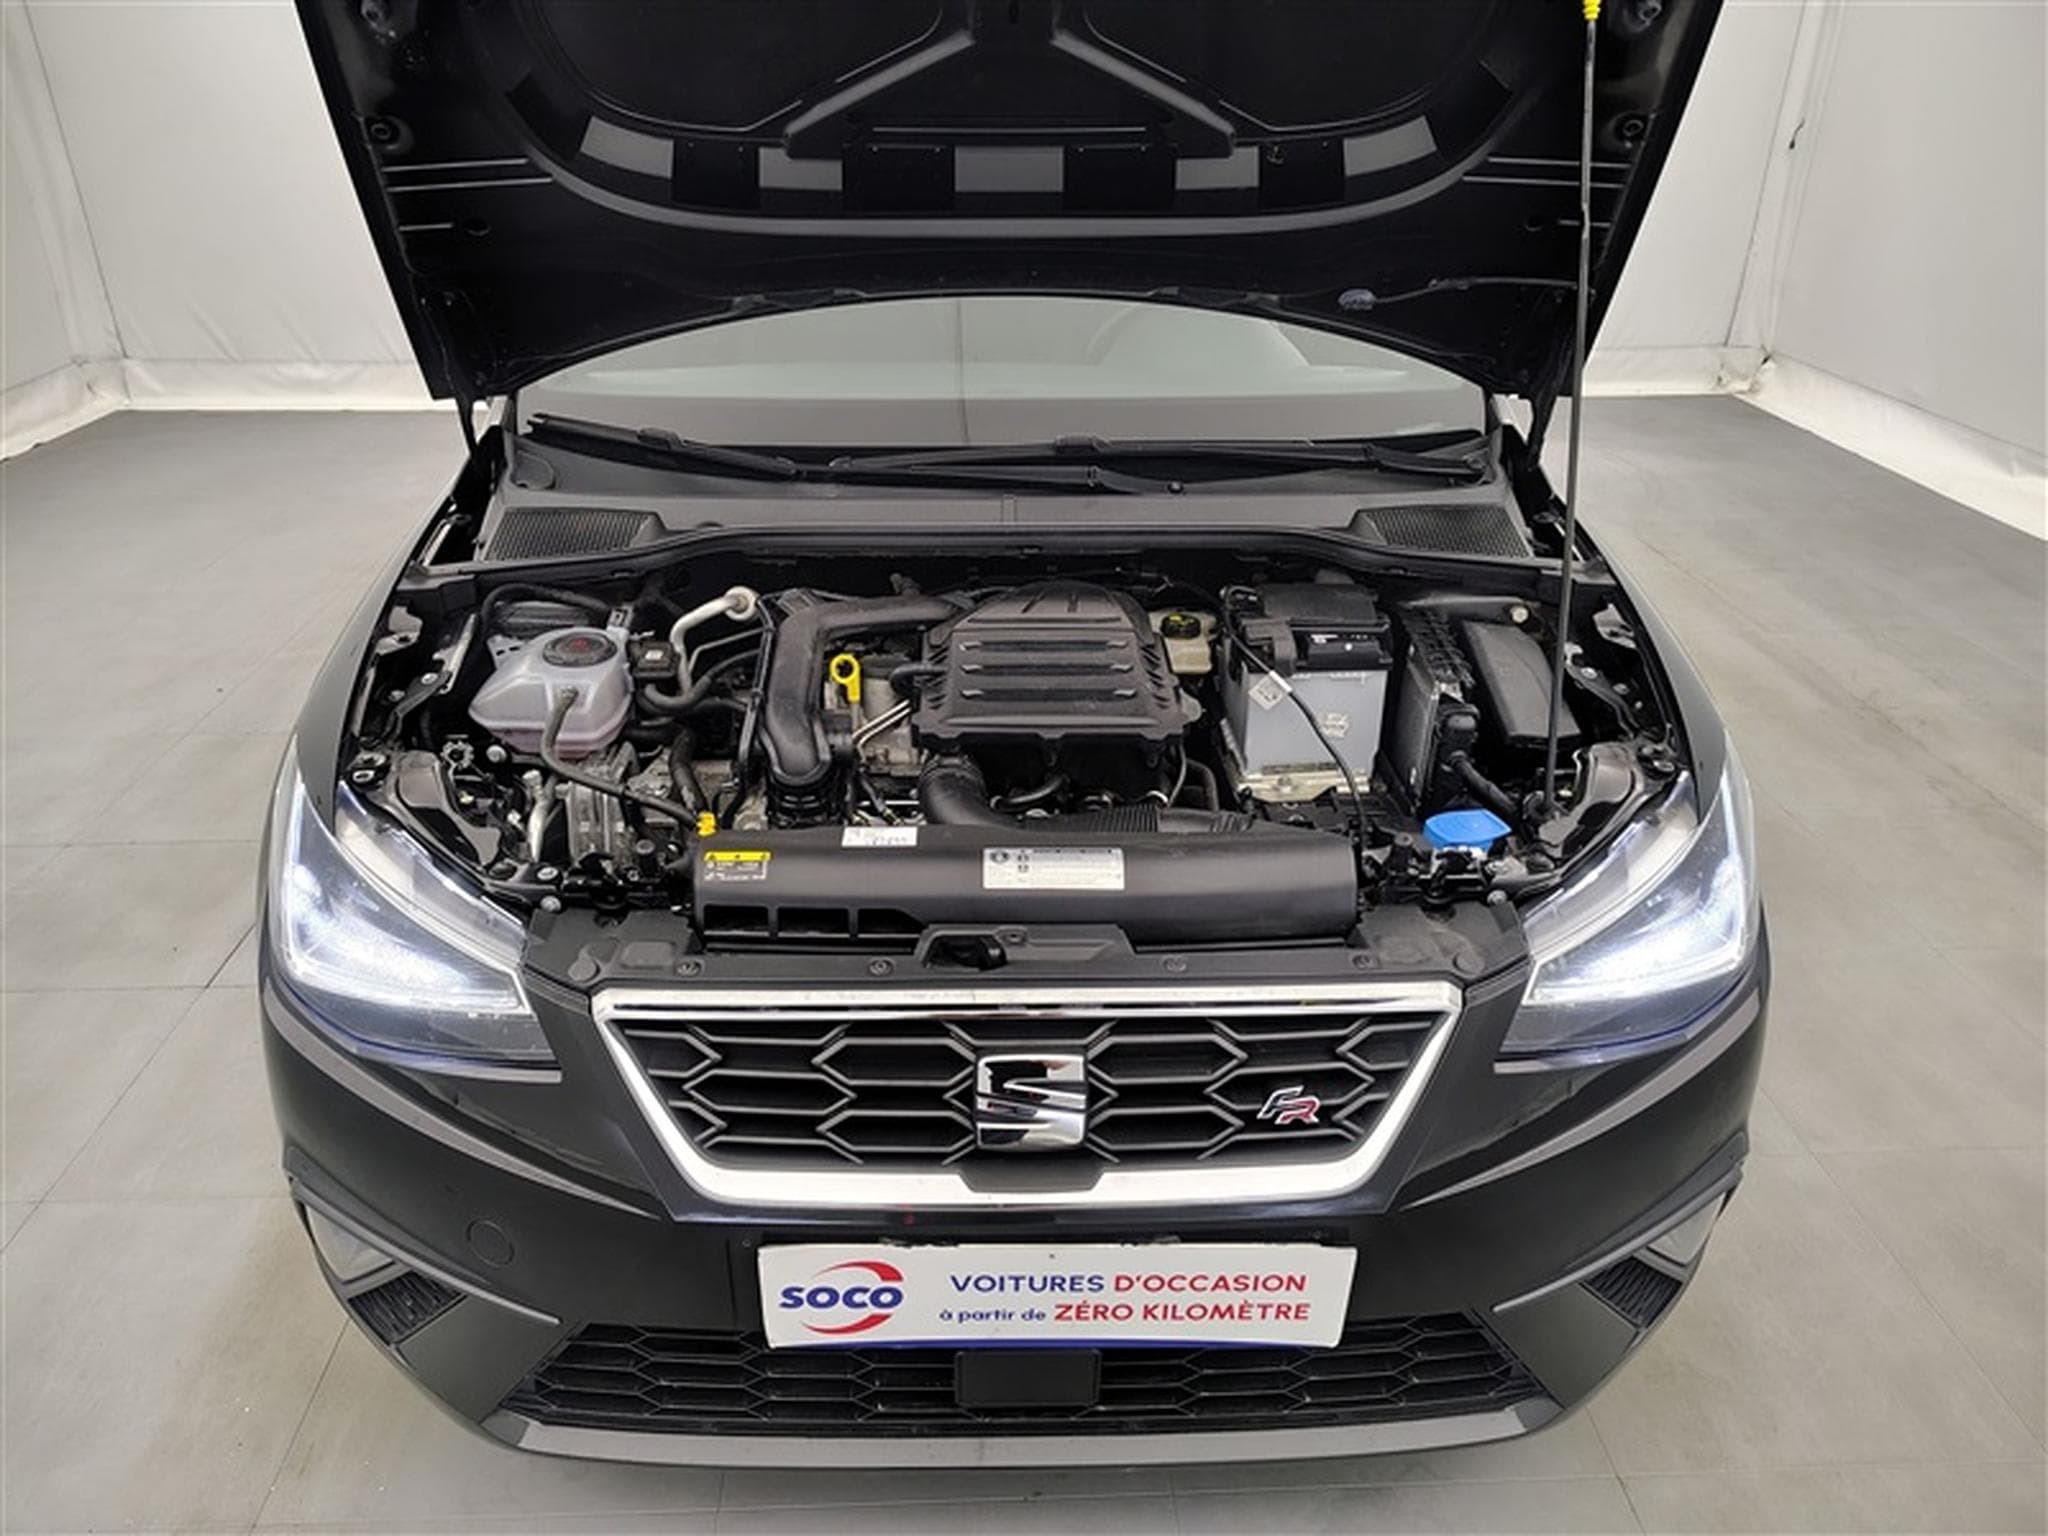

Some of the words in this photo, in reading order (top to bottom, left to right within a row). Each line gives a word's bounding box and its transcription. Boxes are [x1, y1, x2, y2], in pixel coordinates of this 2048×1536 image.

[950, 1274, 1105, 1293] VOITURES
[1113, 1274, 1307, 1293] D'OCCASION
[779, 1285, 904, 1309] SOCO
[939, 1308, 952, 1321] à
[958, 1308, 1015, 1324] partir
[1021, 1308, 1047, 1321] de
[1054, 1300, 1135, 1321] ZÉRO
[1142, 1300, 1312, 1321] KILOMÈTRE
